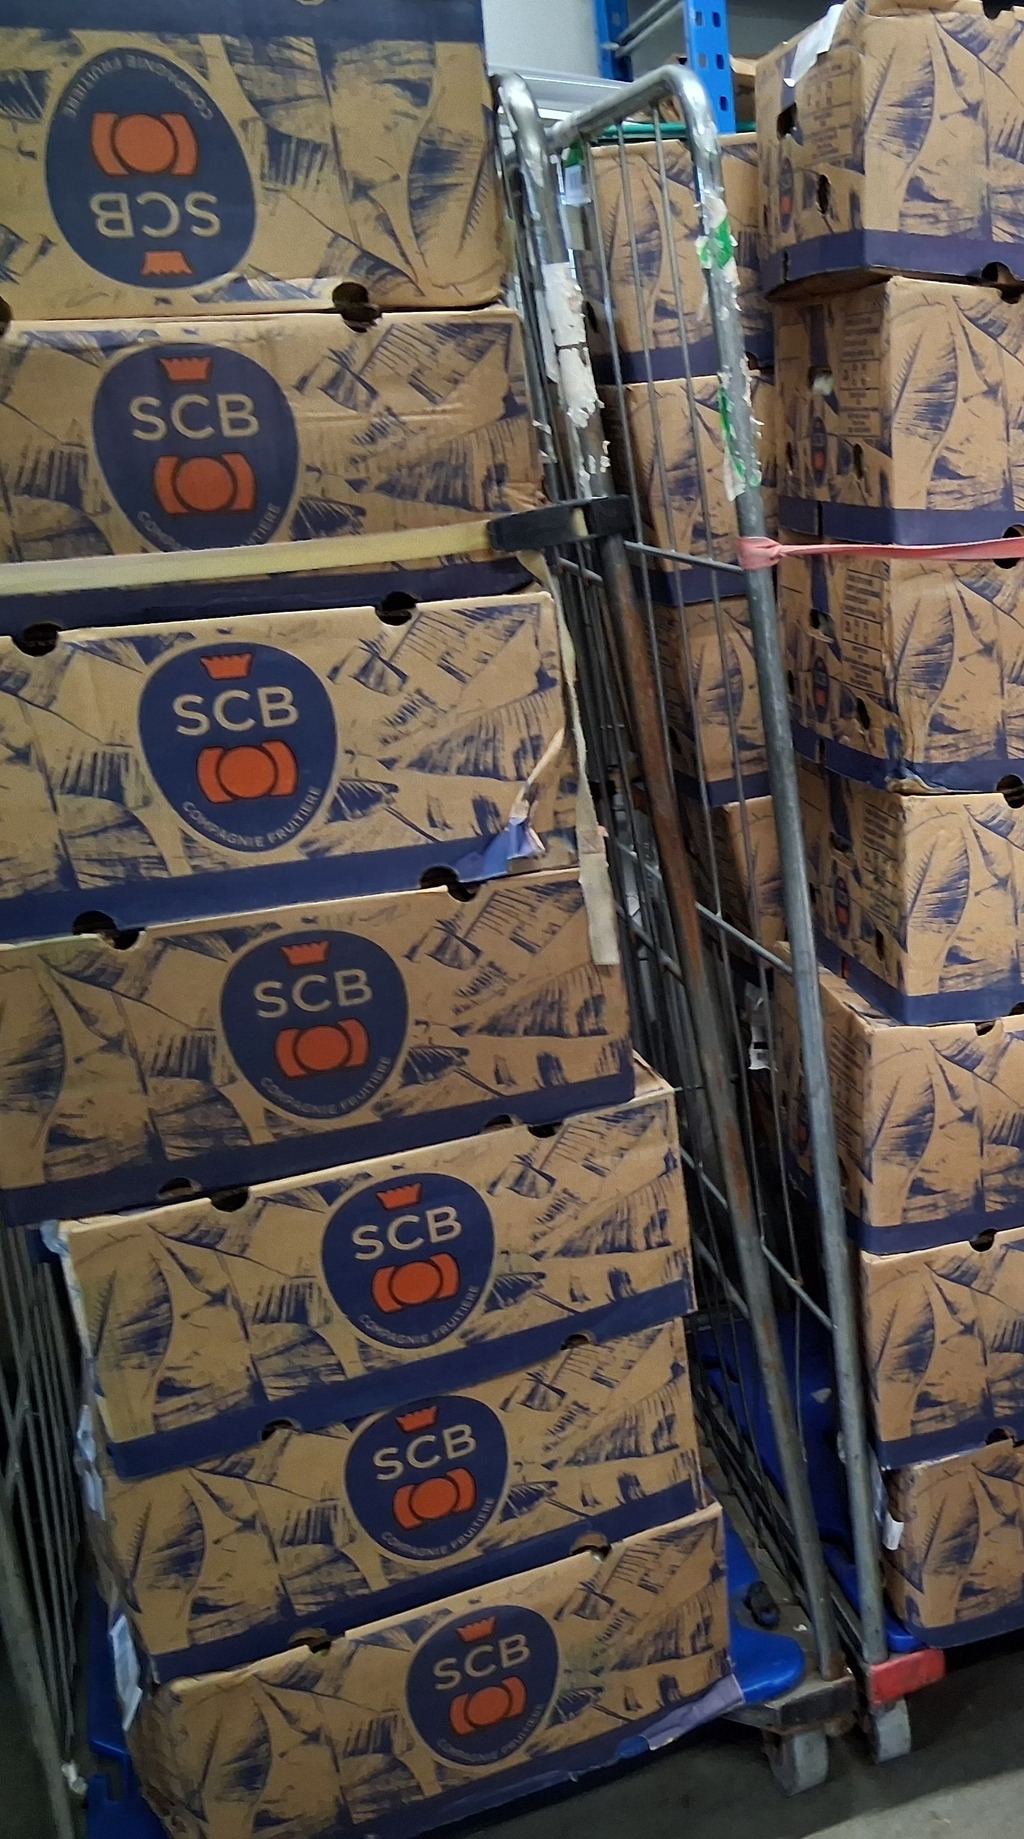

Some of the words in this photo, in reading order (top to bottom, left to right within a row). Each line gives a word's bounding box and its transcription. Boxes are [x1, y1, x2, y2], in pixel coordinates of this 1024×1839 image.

[90, 191, 221, 238] SCB
[129, 393, 260, 441] SCB
[172, 686, 300, 736] SCB
[253, 968, 373, 1019] SCB
[352, 1206, 463, 1260] SCB
[372, 1424, 477, 1481] SCB
[433, 1634, 530, 1690] SCB
